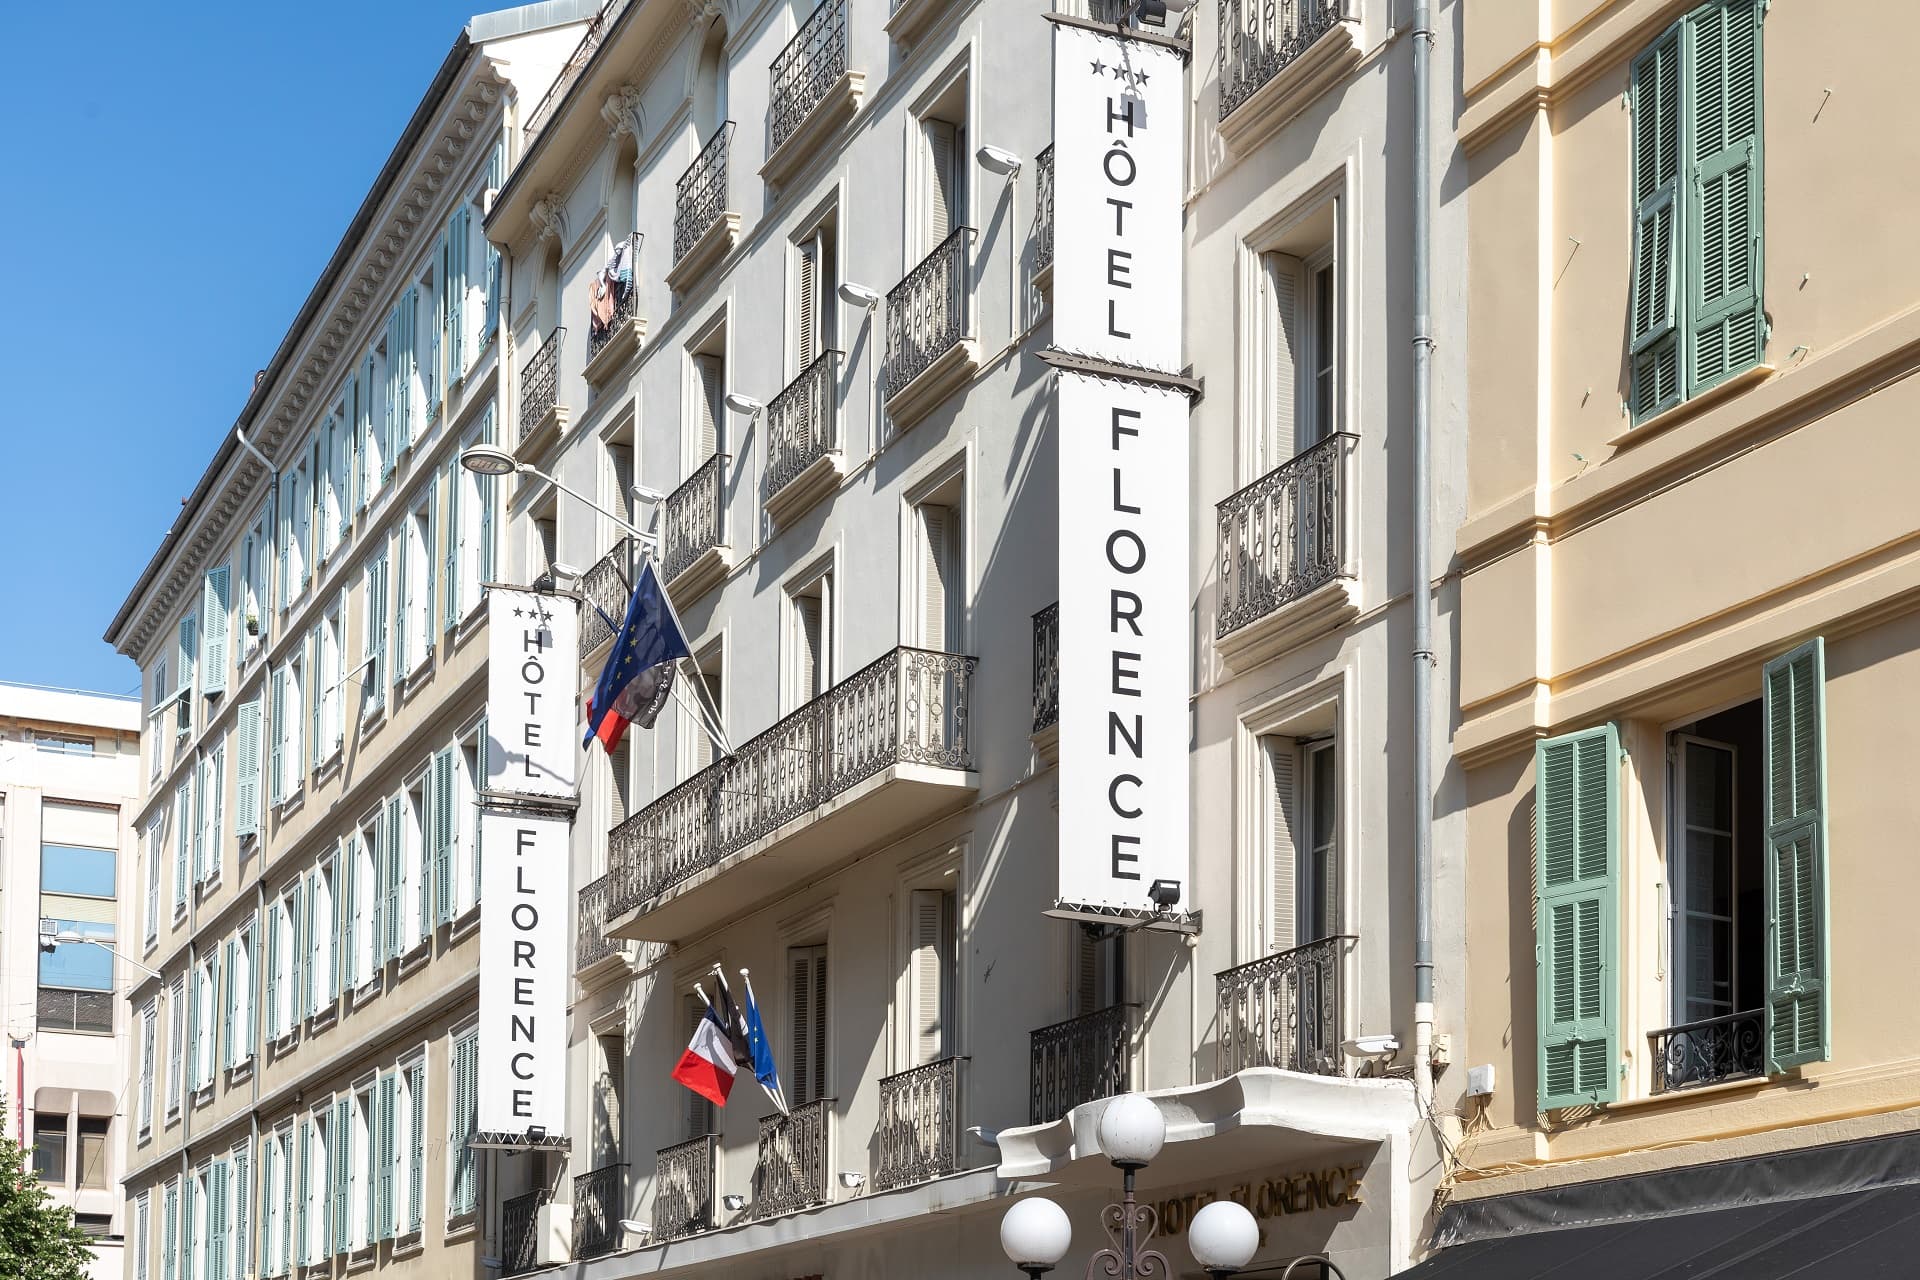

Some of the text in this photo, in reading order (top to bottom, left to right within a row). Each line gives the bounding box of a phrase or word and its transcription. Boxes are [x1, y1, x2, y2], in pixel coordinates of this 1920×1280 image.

[1103, 97, 1137, 340] HÔTEL
[521, 629, 545, 778] HÔTEL
[1105, 407, 1147, 881] FLORENCE
[510, 829, 539, 1118] FLORENCE
